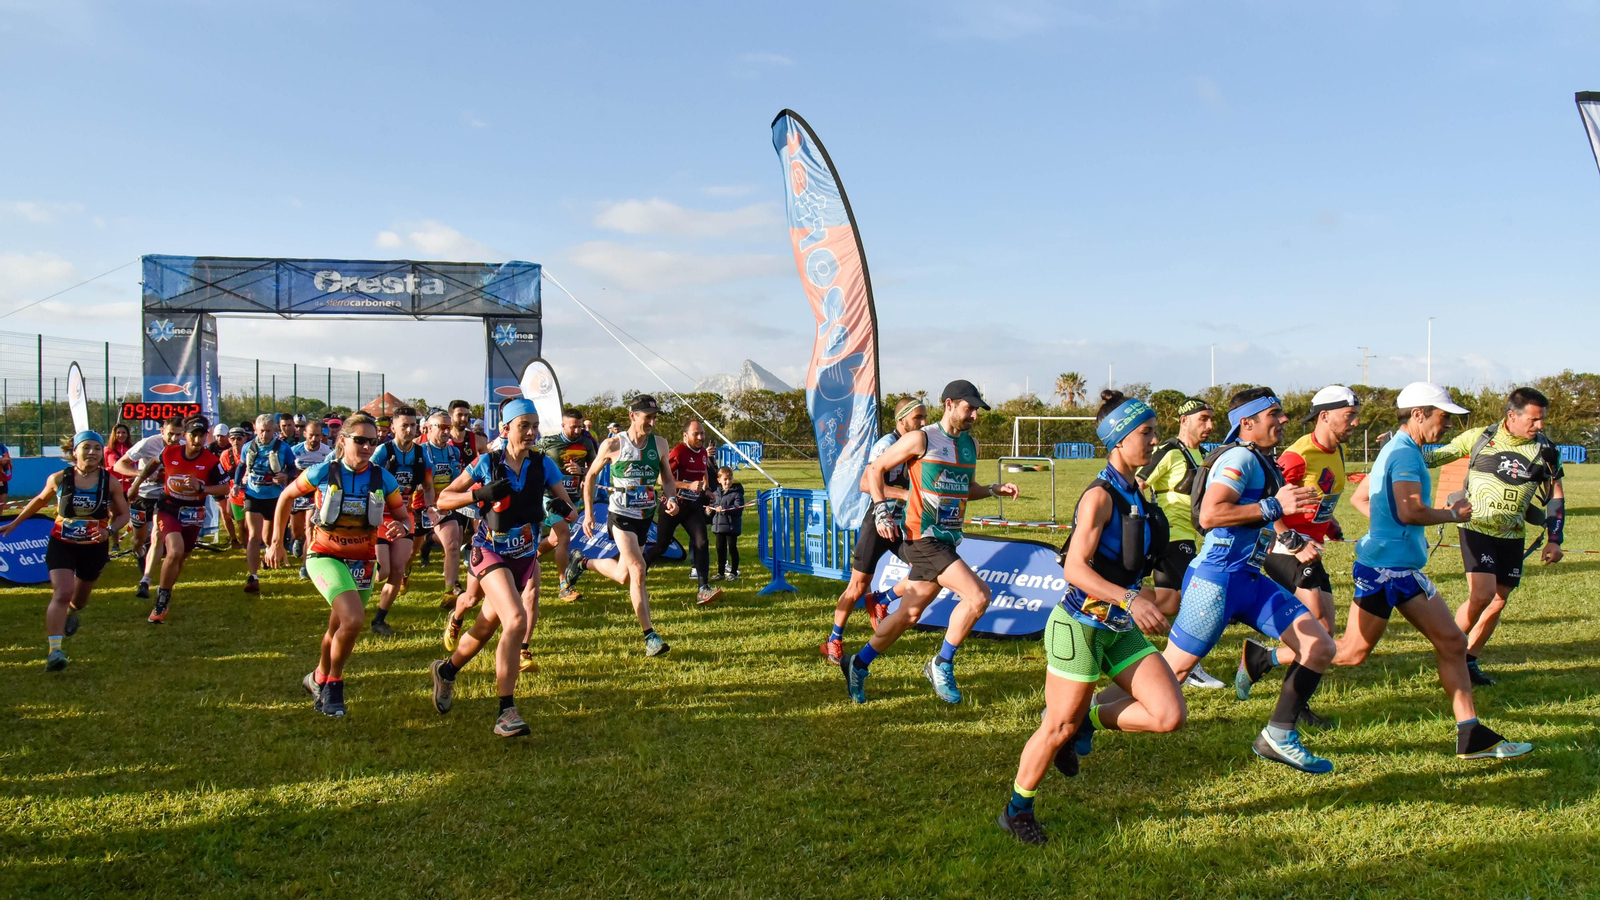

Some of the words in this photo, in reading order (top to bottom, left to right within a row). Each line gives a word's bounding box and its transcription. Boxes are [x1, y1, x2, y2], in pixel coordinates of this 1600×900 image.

[313, 269, 446, 295] Cresta
[123, 403, 200, 420] 09:00:42
[633, 492, 649, 500] 144
[949, 506, 960, 517] 73
[73, 526, 87, 535] 25
[504, 534, 526, 549] 105
[19, 553, 32, 566] de
[990, 589, 1043, 612] ínea
